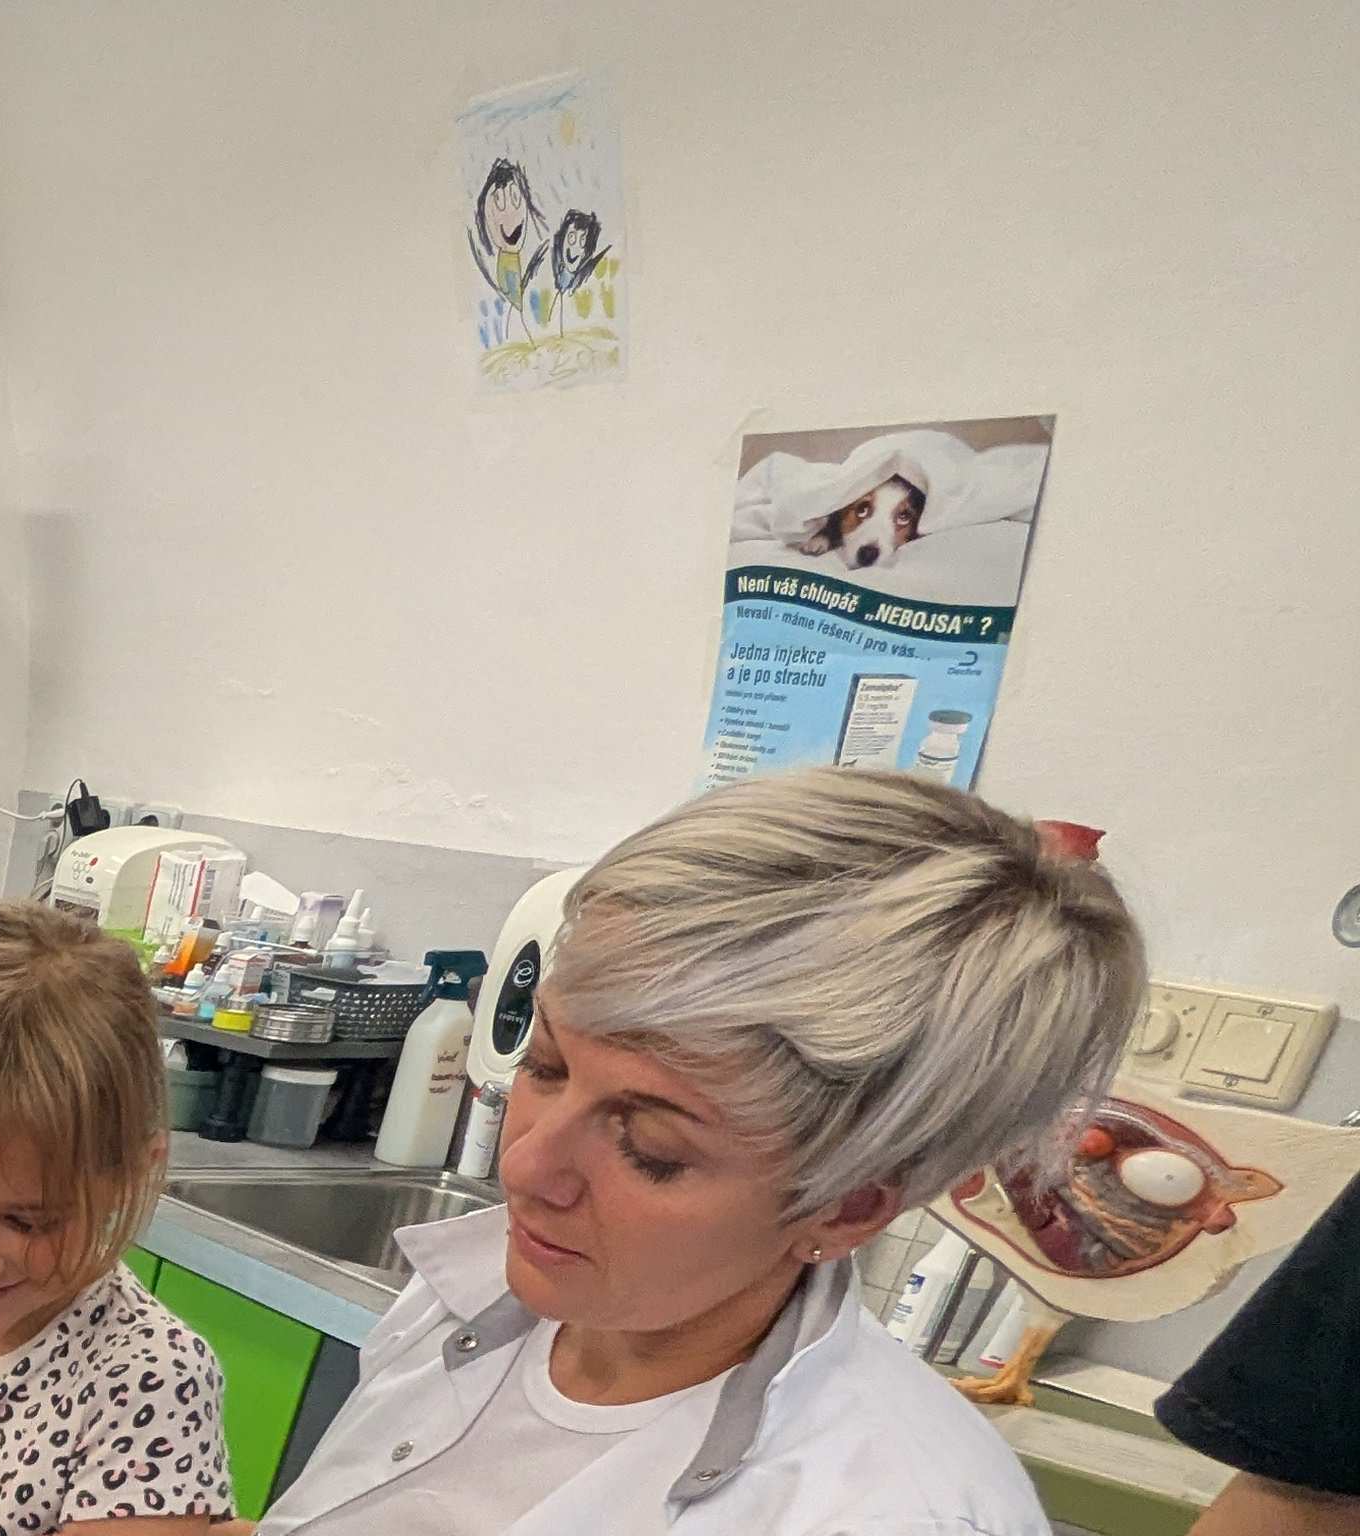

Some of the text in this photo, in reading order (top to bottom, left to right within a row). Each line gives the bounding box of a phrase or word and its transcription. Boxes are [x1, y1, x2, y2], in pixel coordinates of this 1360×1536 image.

[738, 574, 770, 595] Není
[774, 576, 798, 596] váš
[800, 581, 859, 615] chlupáč
[979, 616, 993, 637] ?
[736, 604, 772, 621] Nevadí
[782, 611, 816, 631] máme
[863, 636, 888, 656] pro
[730, 642, 827, 668] Jedna injekce
[738, 664, 752, 684] je
[754, 667, 771, 686] po
[774, 666, 827, 688] strachu
